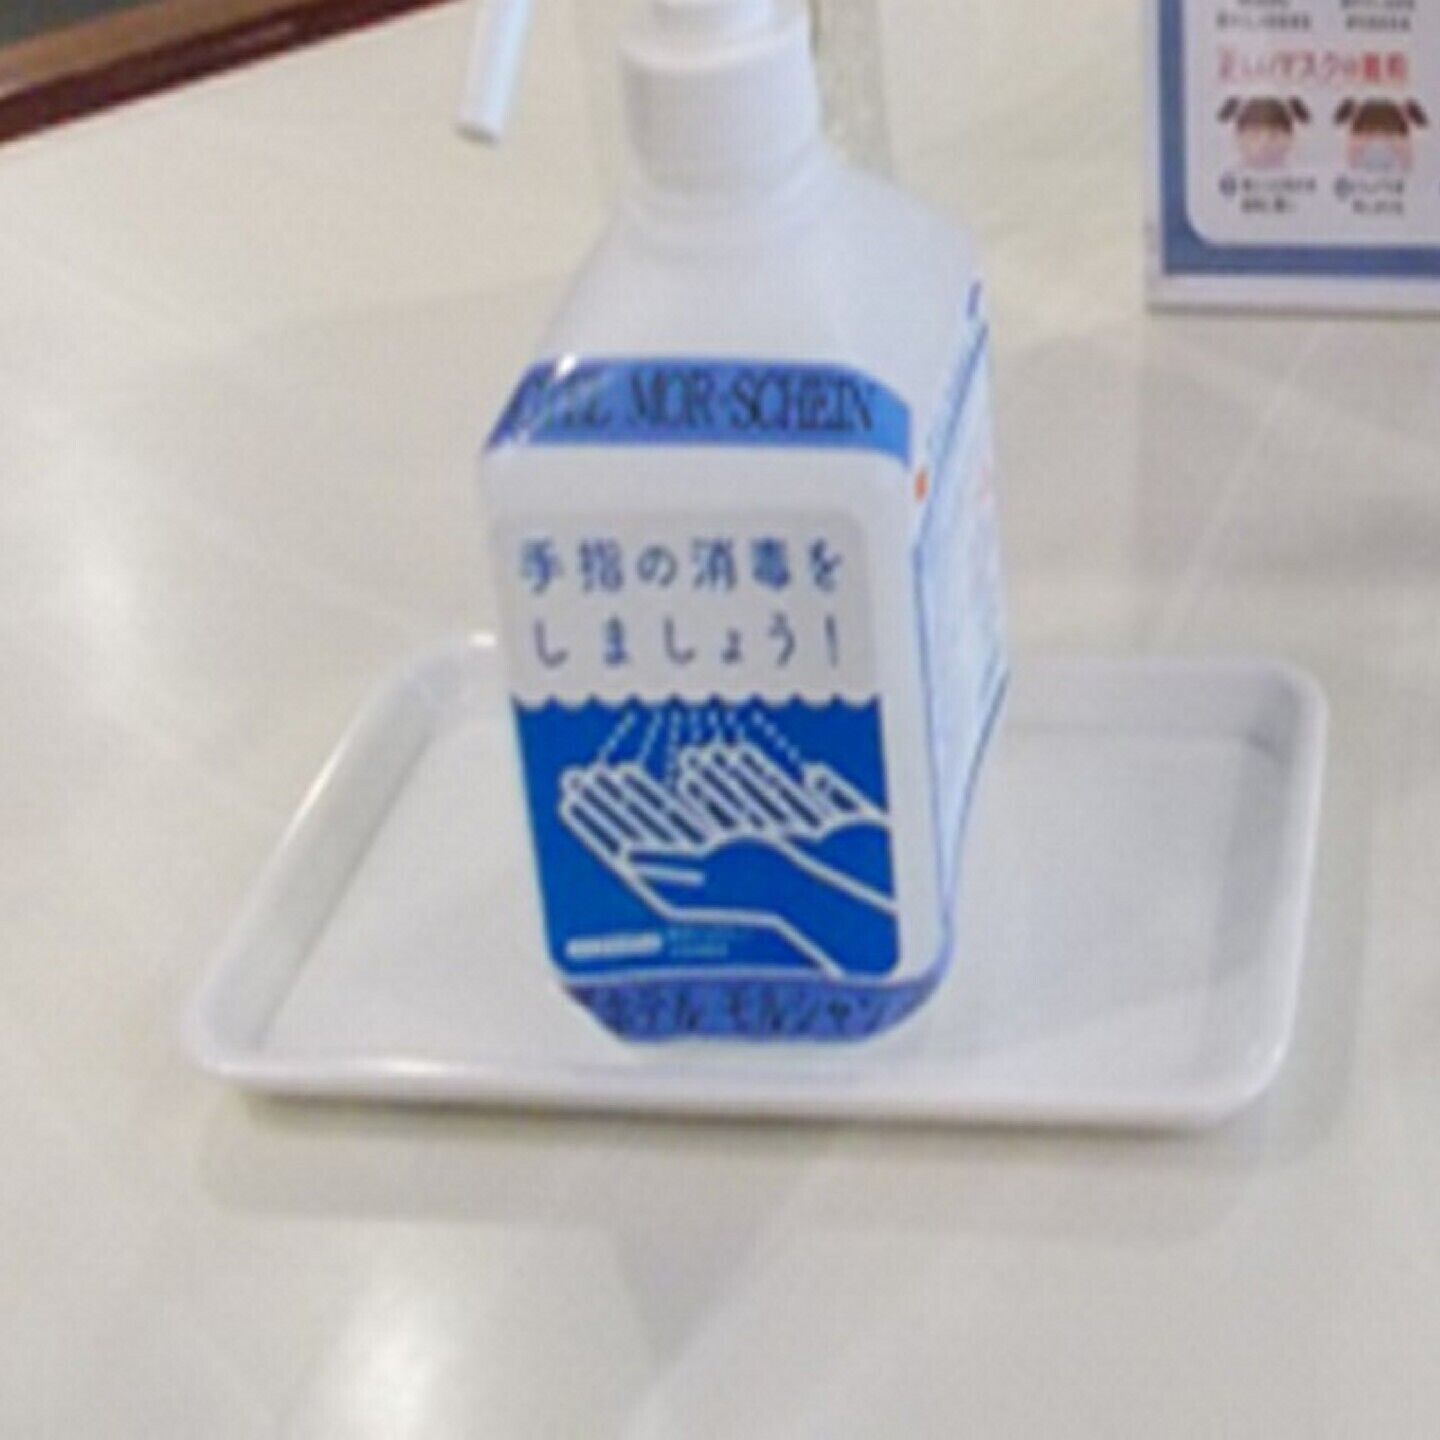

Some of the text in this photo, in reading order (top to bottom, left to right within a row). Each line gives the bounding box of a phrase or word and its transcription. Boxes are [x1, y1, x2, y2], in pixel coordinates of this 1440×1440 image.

[520, 537, 843, 594] 手指の消毒を
